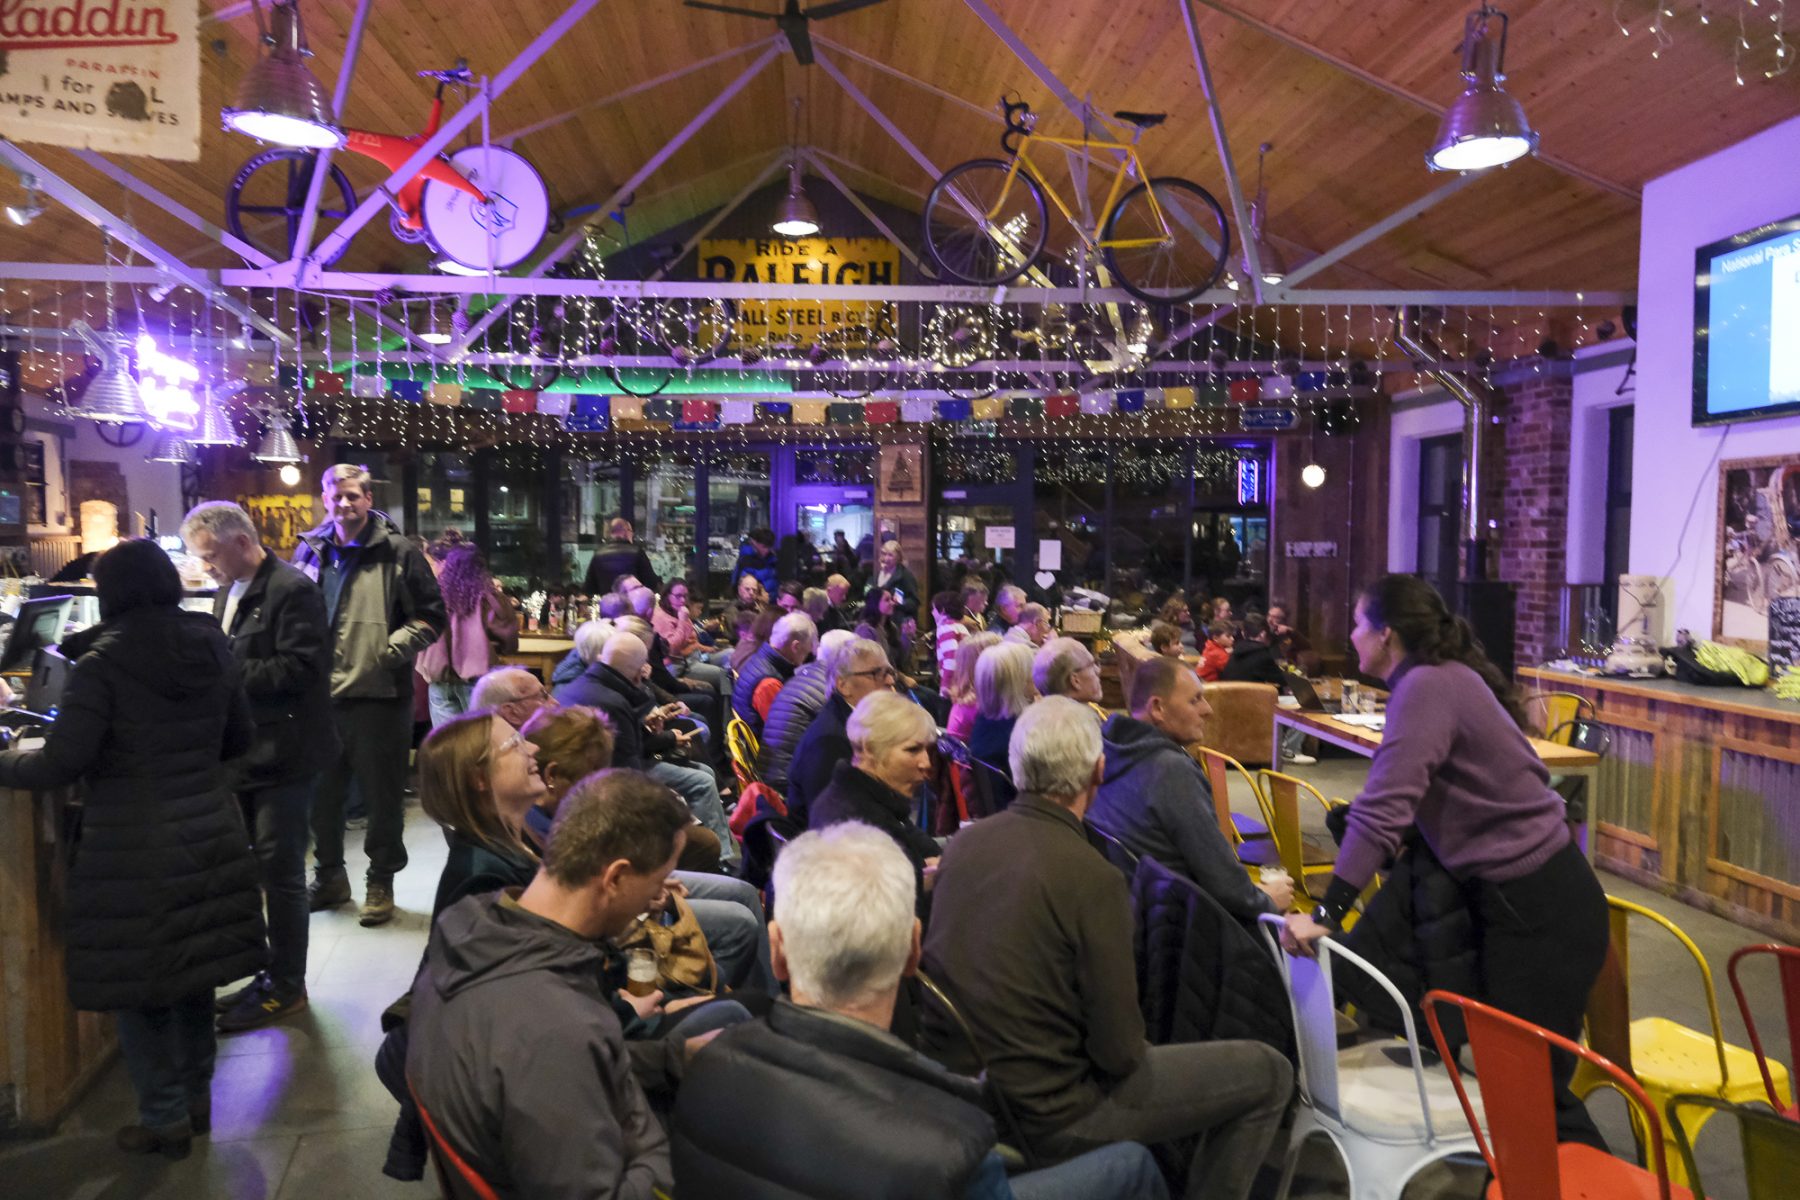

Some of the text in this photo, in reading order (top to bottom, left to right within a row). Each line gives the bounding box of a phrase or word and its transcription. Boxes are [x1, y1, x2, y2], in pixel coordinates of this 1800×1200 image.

[60, 75, 96, 94] for
[0, 92, 46, 109] MPS
[53, 98, 97, 115] AND
[756, 243, 839, 257] RIDE A
